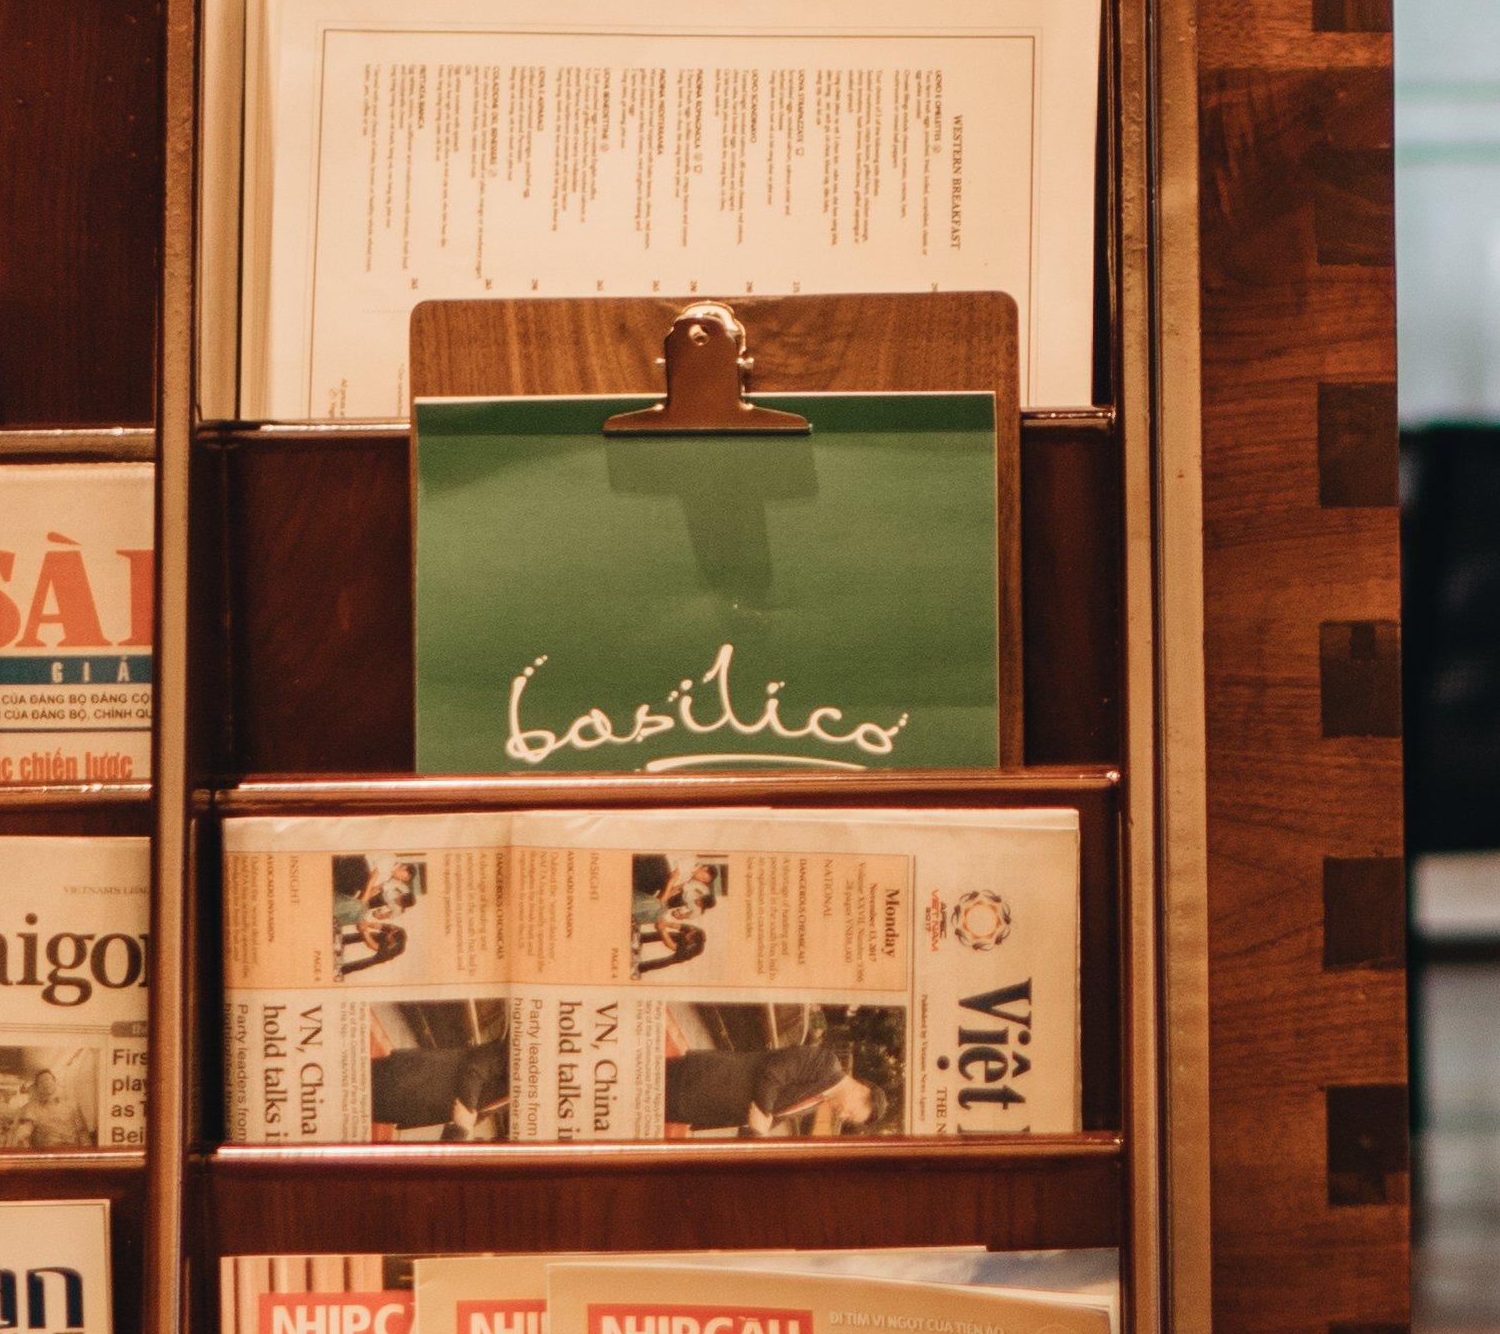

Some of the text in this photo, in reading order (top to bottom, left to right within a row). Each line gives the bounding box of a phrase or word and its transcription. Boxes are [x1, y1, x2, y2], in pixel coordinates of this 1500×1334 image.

[949, 115, 964, 249] WESTERN BREAKFAST
[505, 643, 909, 763] basilico
[289, 855, 300, 906] INSIGHT
[589, 852, 599, 902] INSIGHT
[823, 859, 834, 919] NATIONAL
[881, 888, 901, 958] Monday
[235, 1003, 249, 1141] Party leaders from
[263, 1004, 288, 1122] hold talks
[296, 1005, 324, 1135] VN, China
[527, 999, 543, 1136] Party leaders from
[558, 1000, 581, 1119] hold talks
[593, 1001, 620, 1132] VN, China
[936, 1088, 948, 1118] THE
[937, 977, 1032, 1110] Việt
[111, 1103, 135, 1118] as
